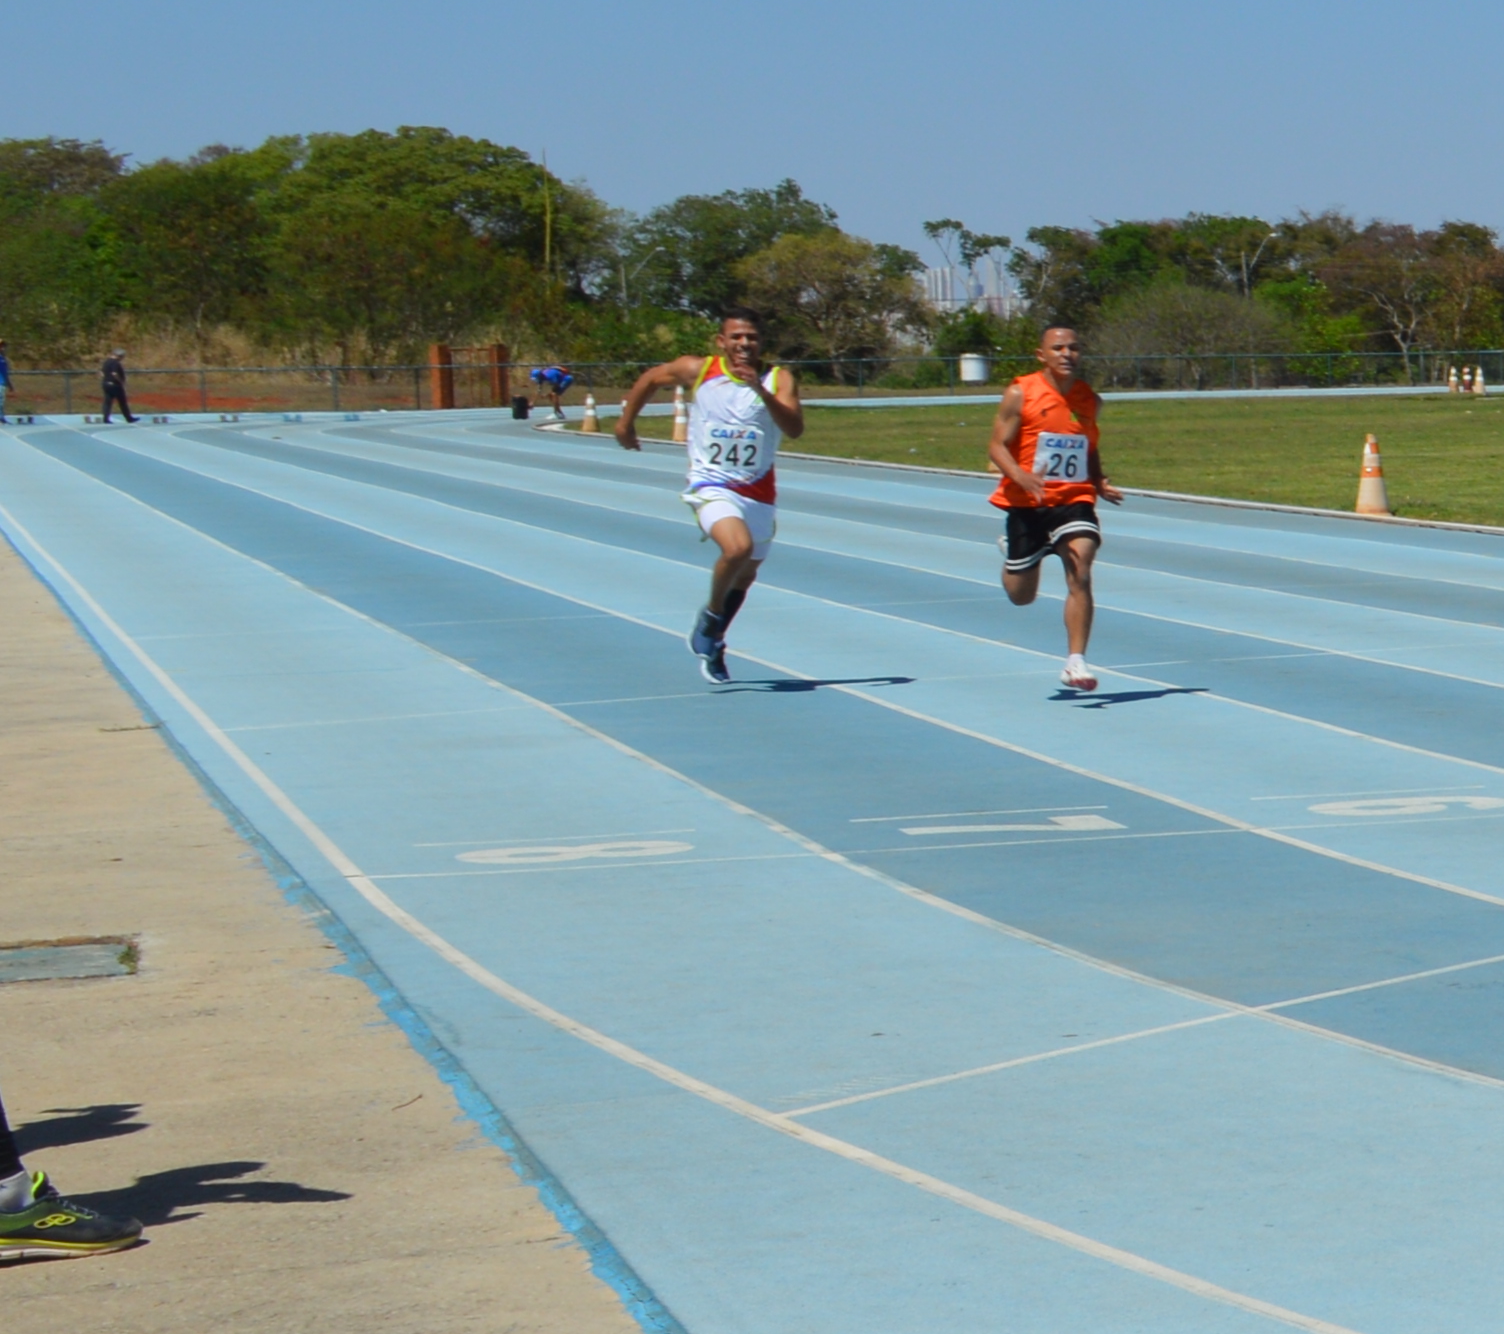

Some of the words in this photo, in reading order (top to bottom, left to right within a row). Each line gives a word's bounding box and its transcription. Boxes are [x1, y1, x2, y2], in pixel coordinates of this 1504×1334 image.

[710, 428, 756, 440] CAIXA
[1045, 438, 1084, 449] CAIXA
[708, 442, 757, 467] 242
[1046, 453, 1078, 478] 26
